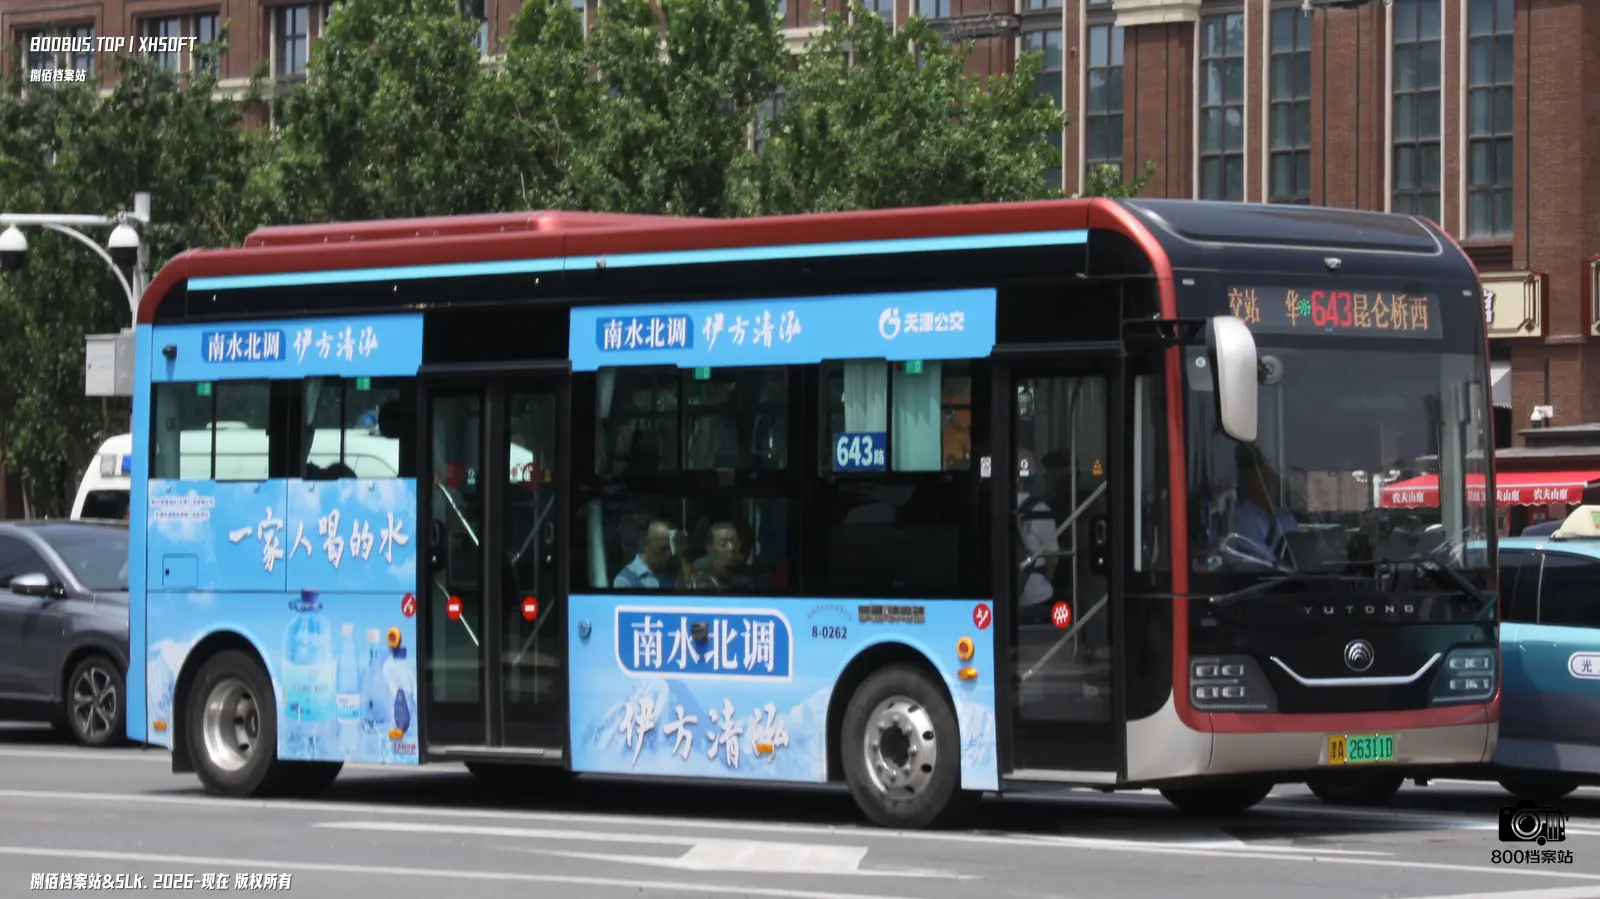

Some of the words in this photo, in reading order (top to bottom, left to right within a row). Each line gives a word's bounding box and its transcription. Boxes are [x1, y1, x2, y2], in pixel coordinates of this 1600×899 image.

[904, 311, 965, 333] 天津公交
[1311, 290, 1352, 327] 643
[1353, 293, 1429, 331] 昆仑桥西
[208, 331, 281, 362] 南水北调
[603, 316, 688, 350] 南水北调
[836, 435, 885, 467] 643路
[228, 506, 410, 572] 一家人喝的水
[1303, 604, 1414, 615] YUTONG
[630, 615, 776, 673] 南水北调
